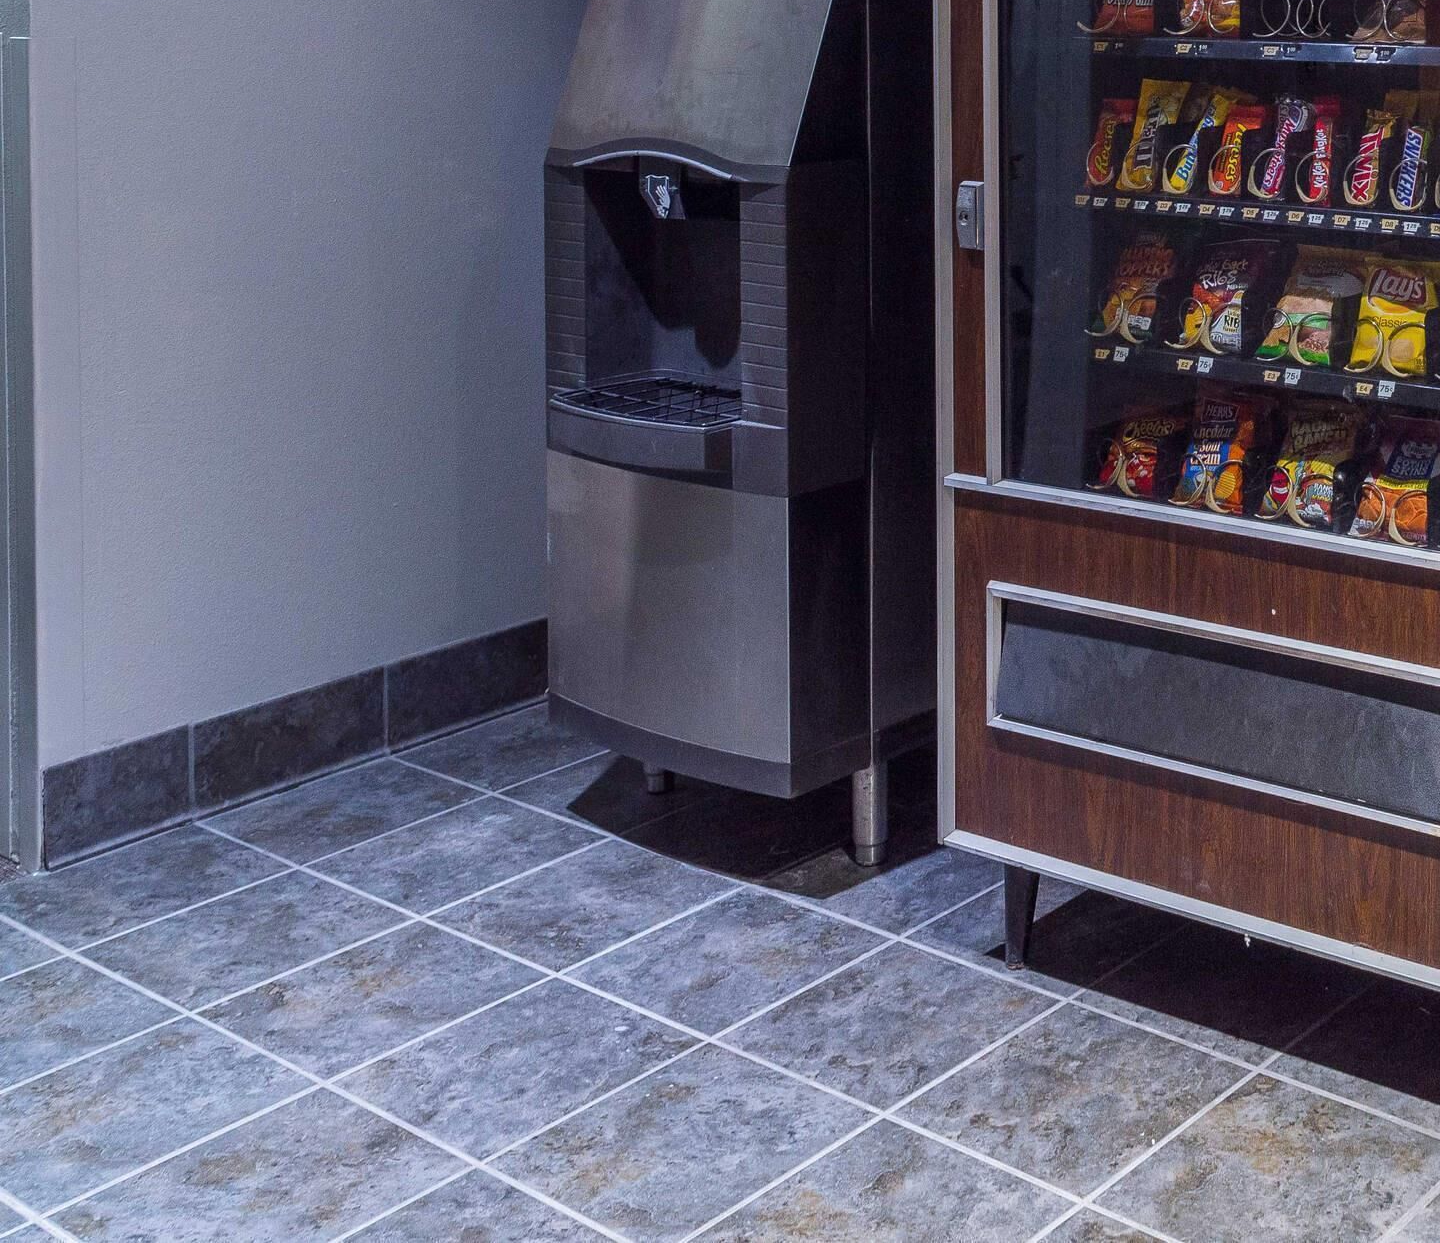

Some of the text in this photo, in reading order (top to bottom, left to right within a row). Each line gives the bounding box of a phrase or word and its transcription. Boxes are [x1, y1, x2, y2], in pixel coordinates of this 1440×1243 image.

[1396, 130, 1422, 208] SNICKERS
[1370, 268, 1424, 301] Lay's
[1121, 420, 1175, 441] Cheetos
[1199, 438, 1223, 453] Sour
